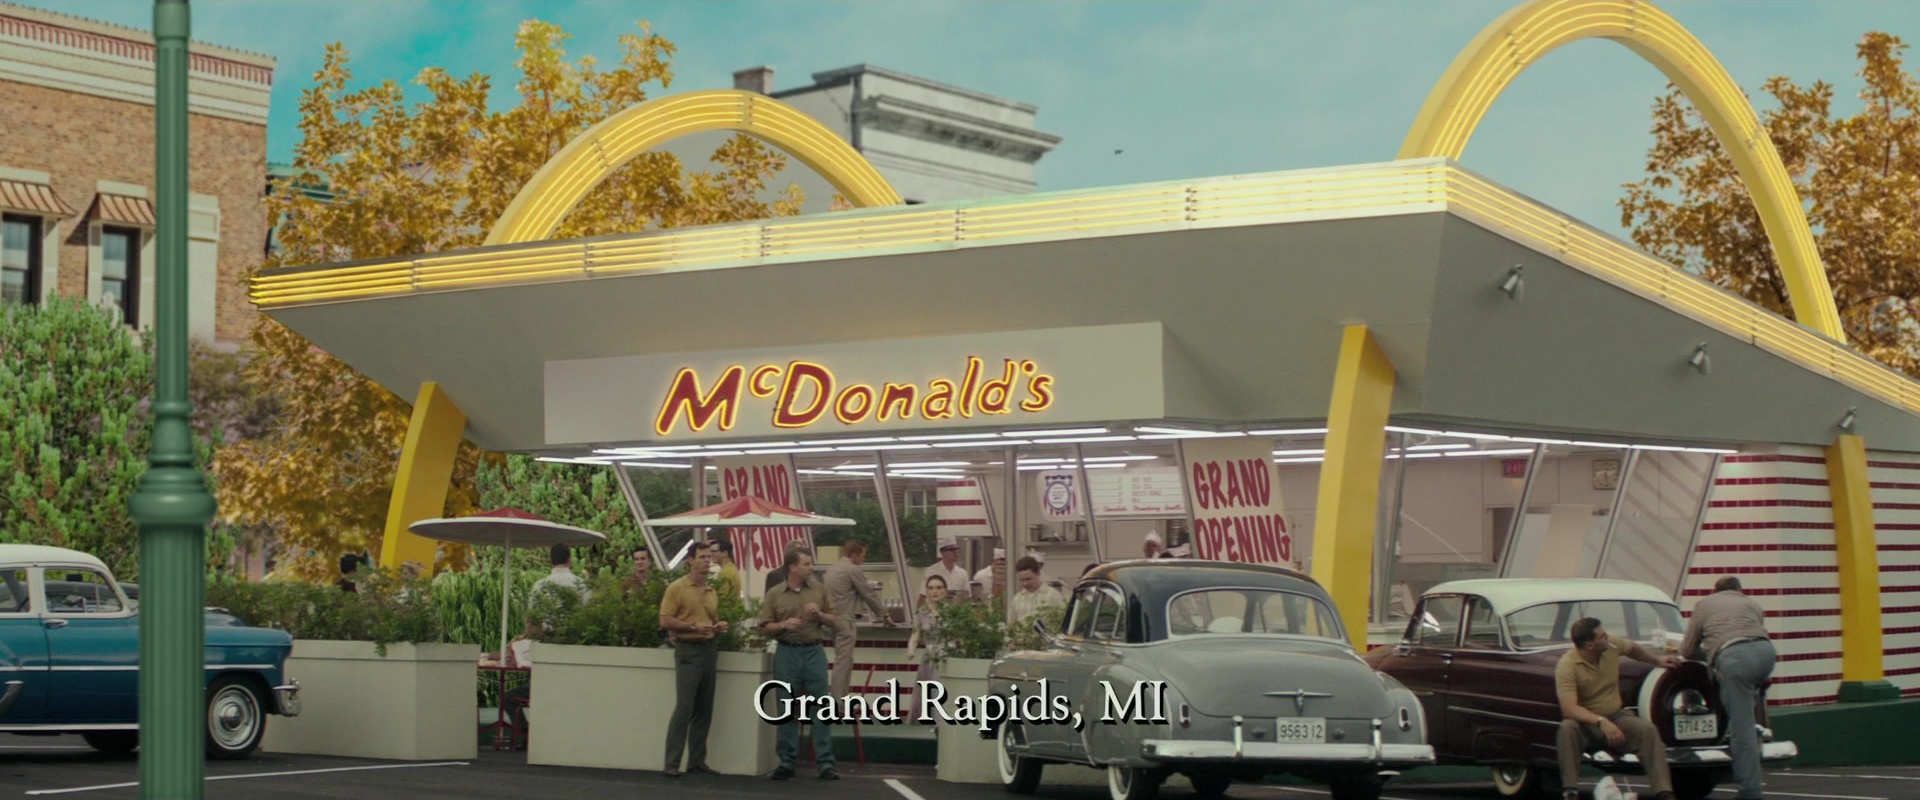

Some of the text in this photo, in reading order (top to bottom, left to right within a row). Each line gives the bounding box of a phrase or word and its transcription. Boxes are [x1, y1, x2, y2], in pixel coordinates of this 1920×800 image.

[655, 355, 1054, 436] McDonald's
[724, 463, 791, 509] GRAND
[1193, 458, 1271, 510] GRAND
[1194, 514, 1292, 564] OPENING
[1280, 724, 1323, 738] 9563 12
